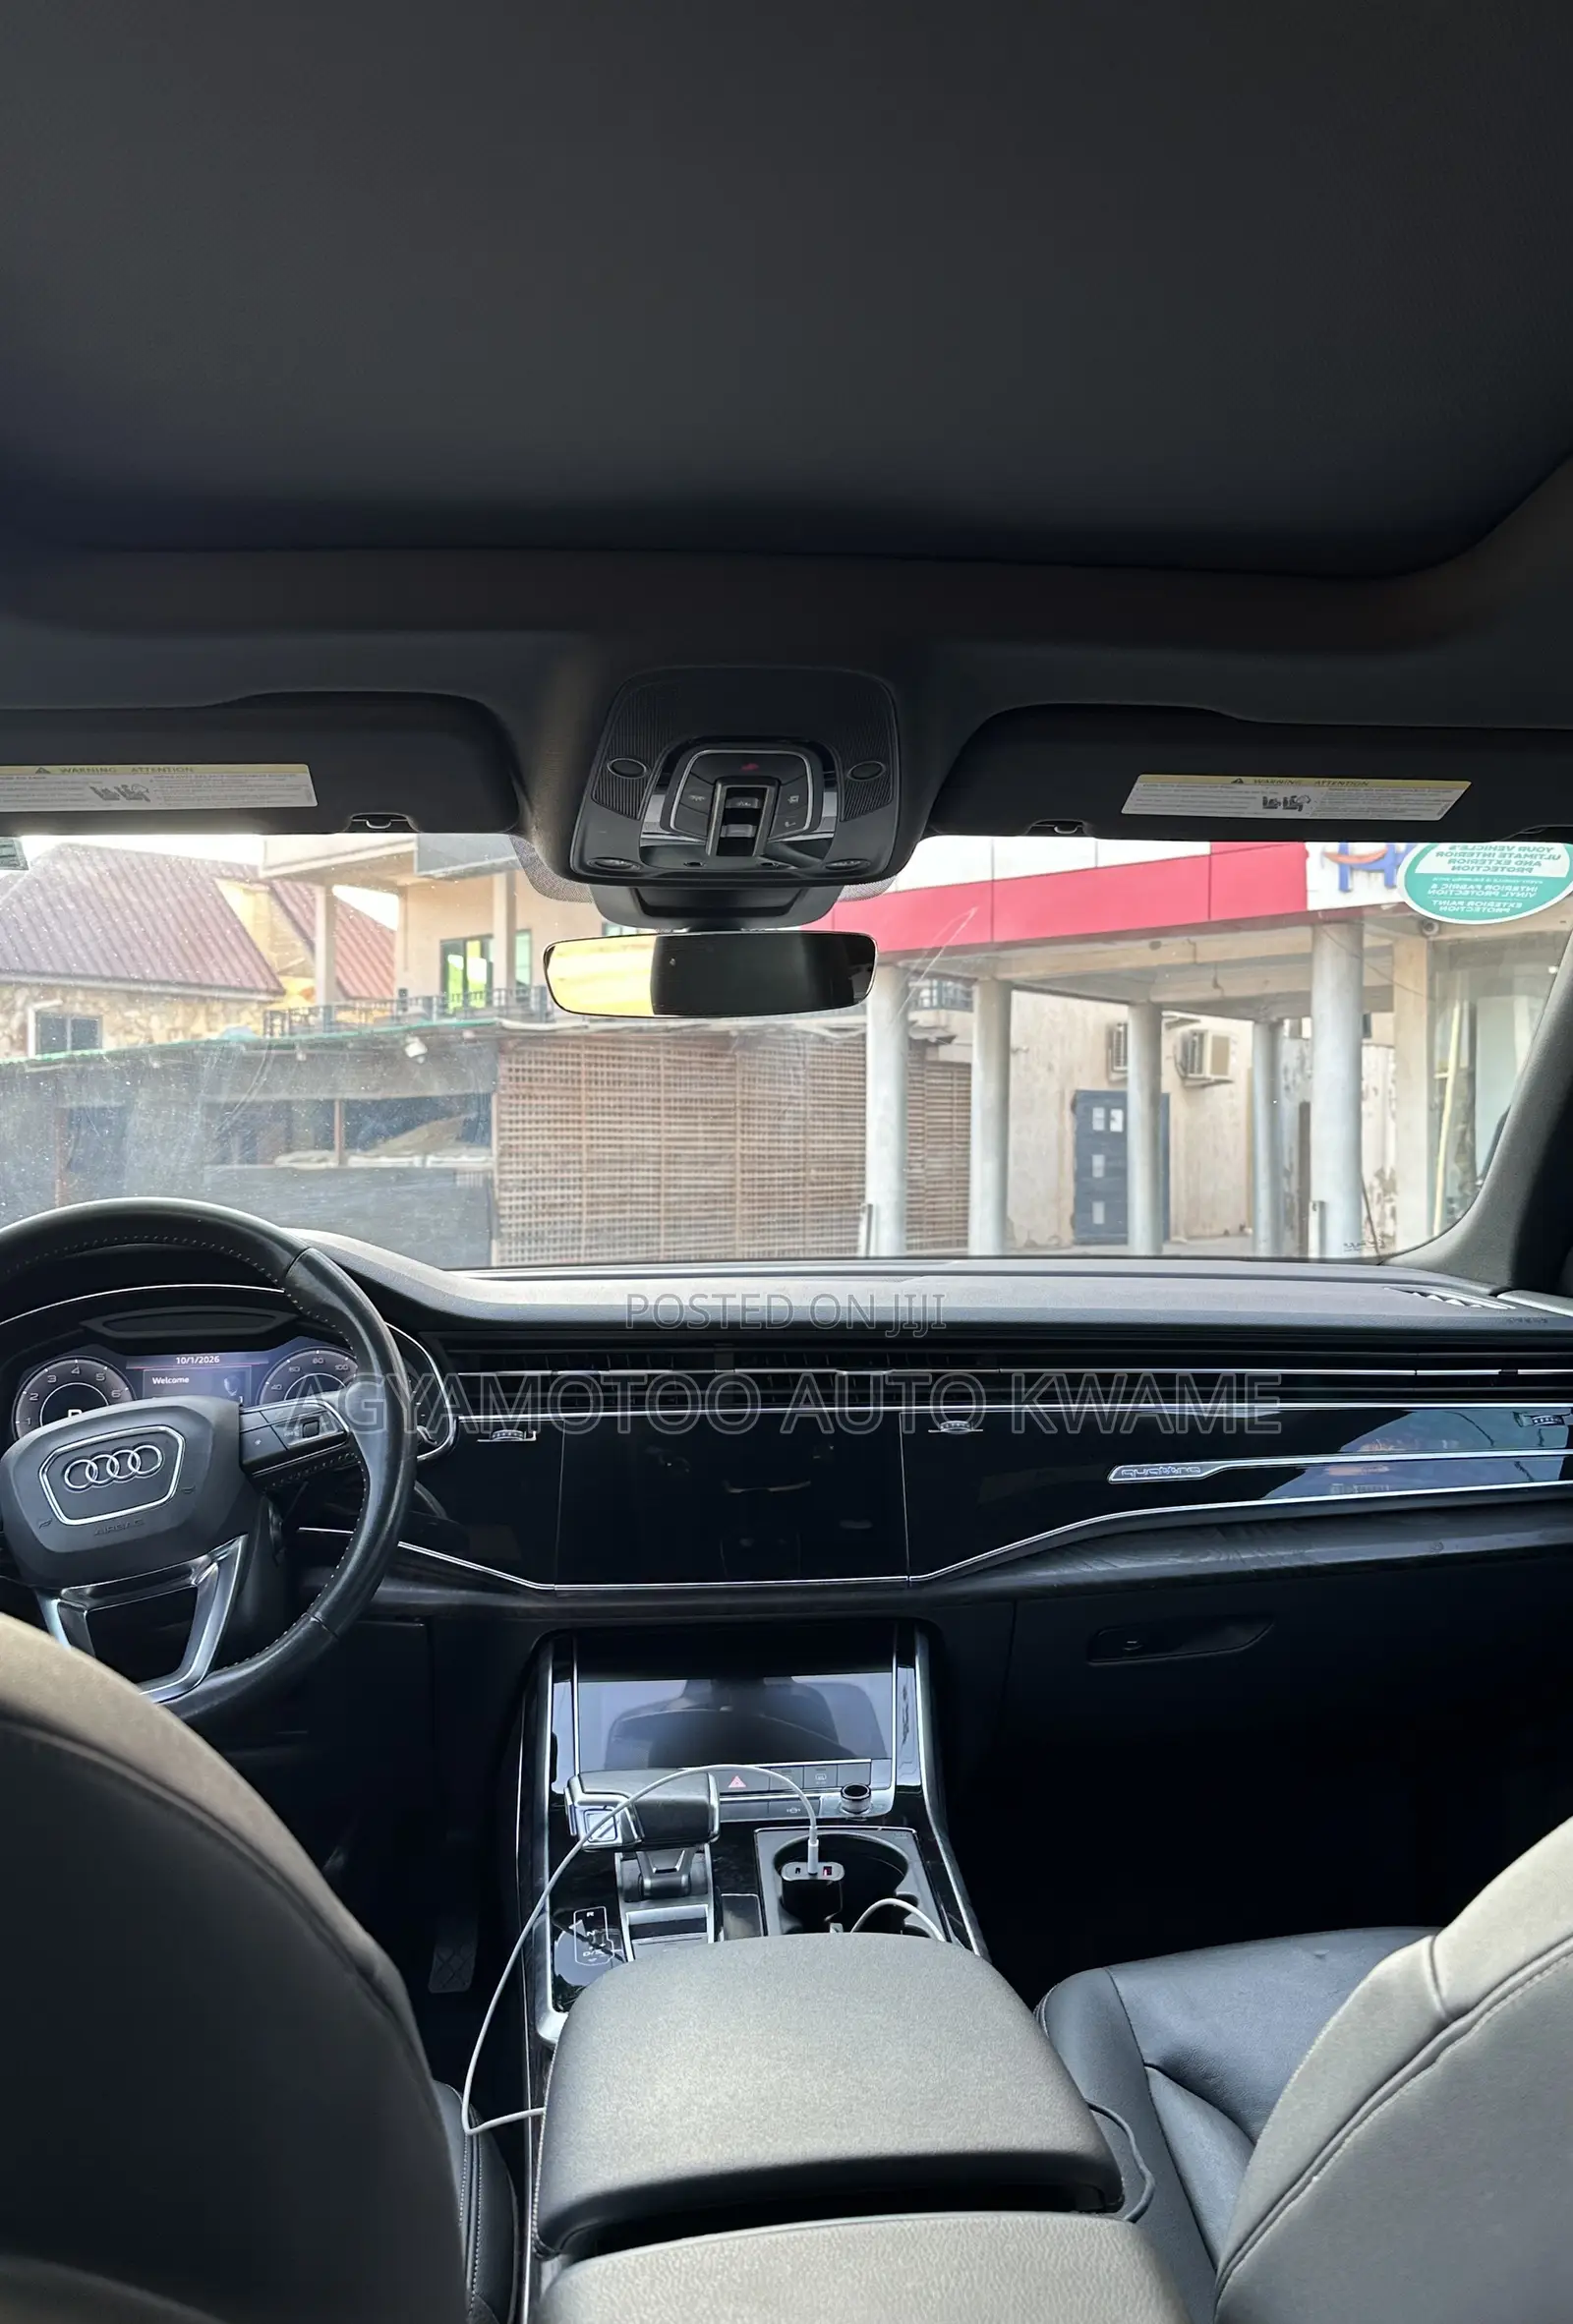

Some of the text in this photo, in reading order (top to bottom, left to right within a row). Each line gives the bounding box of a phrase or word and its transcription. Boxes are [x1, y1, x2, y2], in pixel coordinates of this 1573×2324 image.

[131, 765, 194, 774] ATTENTION
[175, 1356, 220, 1365] 10/1/2026
[71, 1365, 82, 1375] 4
[95, 1372, 106, 1381] 5
[151, 1375, 191, 1385] Welcome
[29, 1392, 39, 1402] 2
[110, 1389, 122, 1399] 6
[25, 1417, 32, 1425] 1
